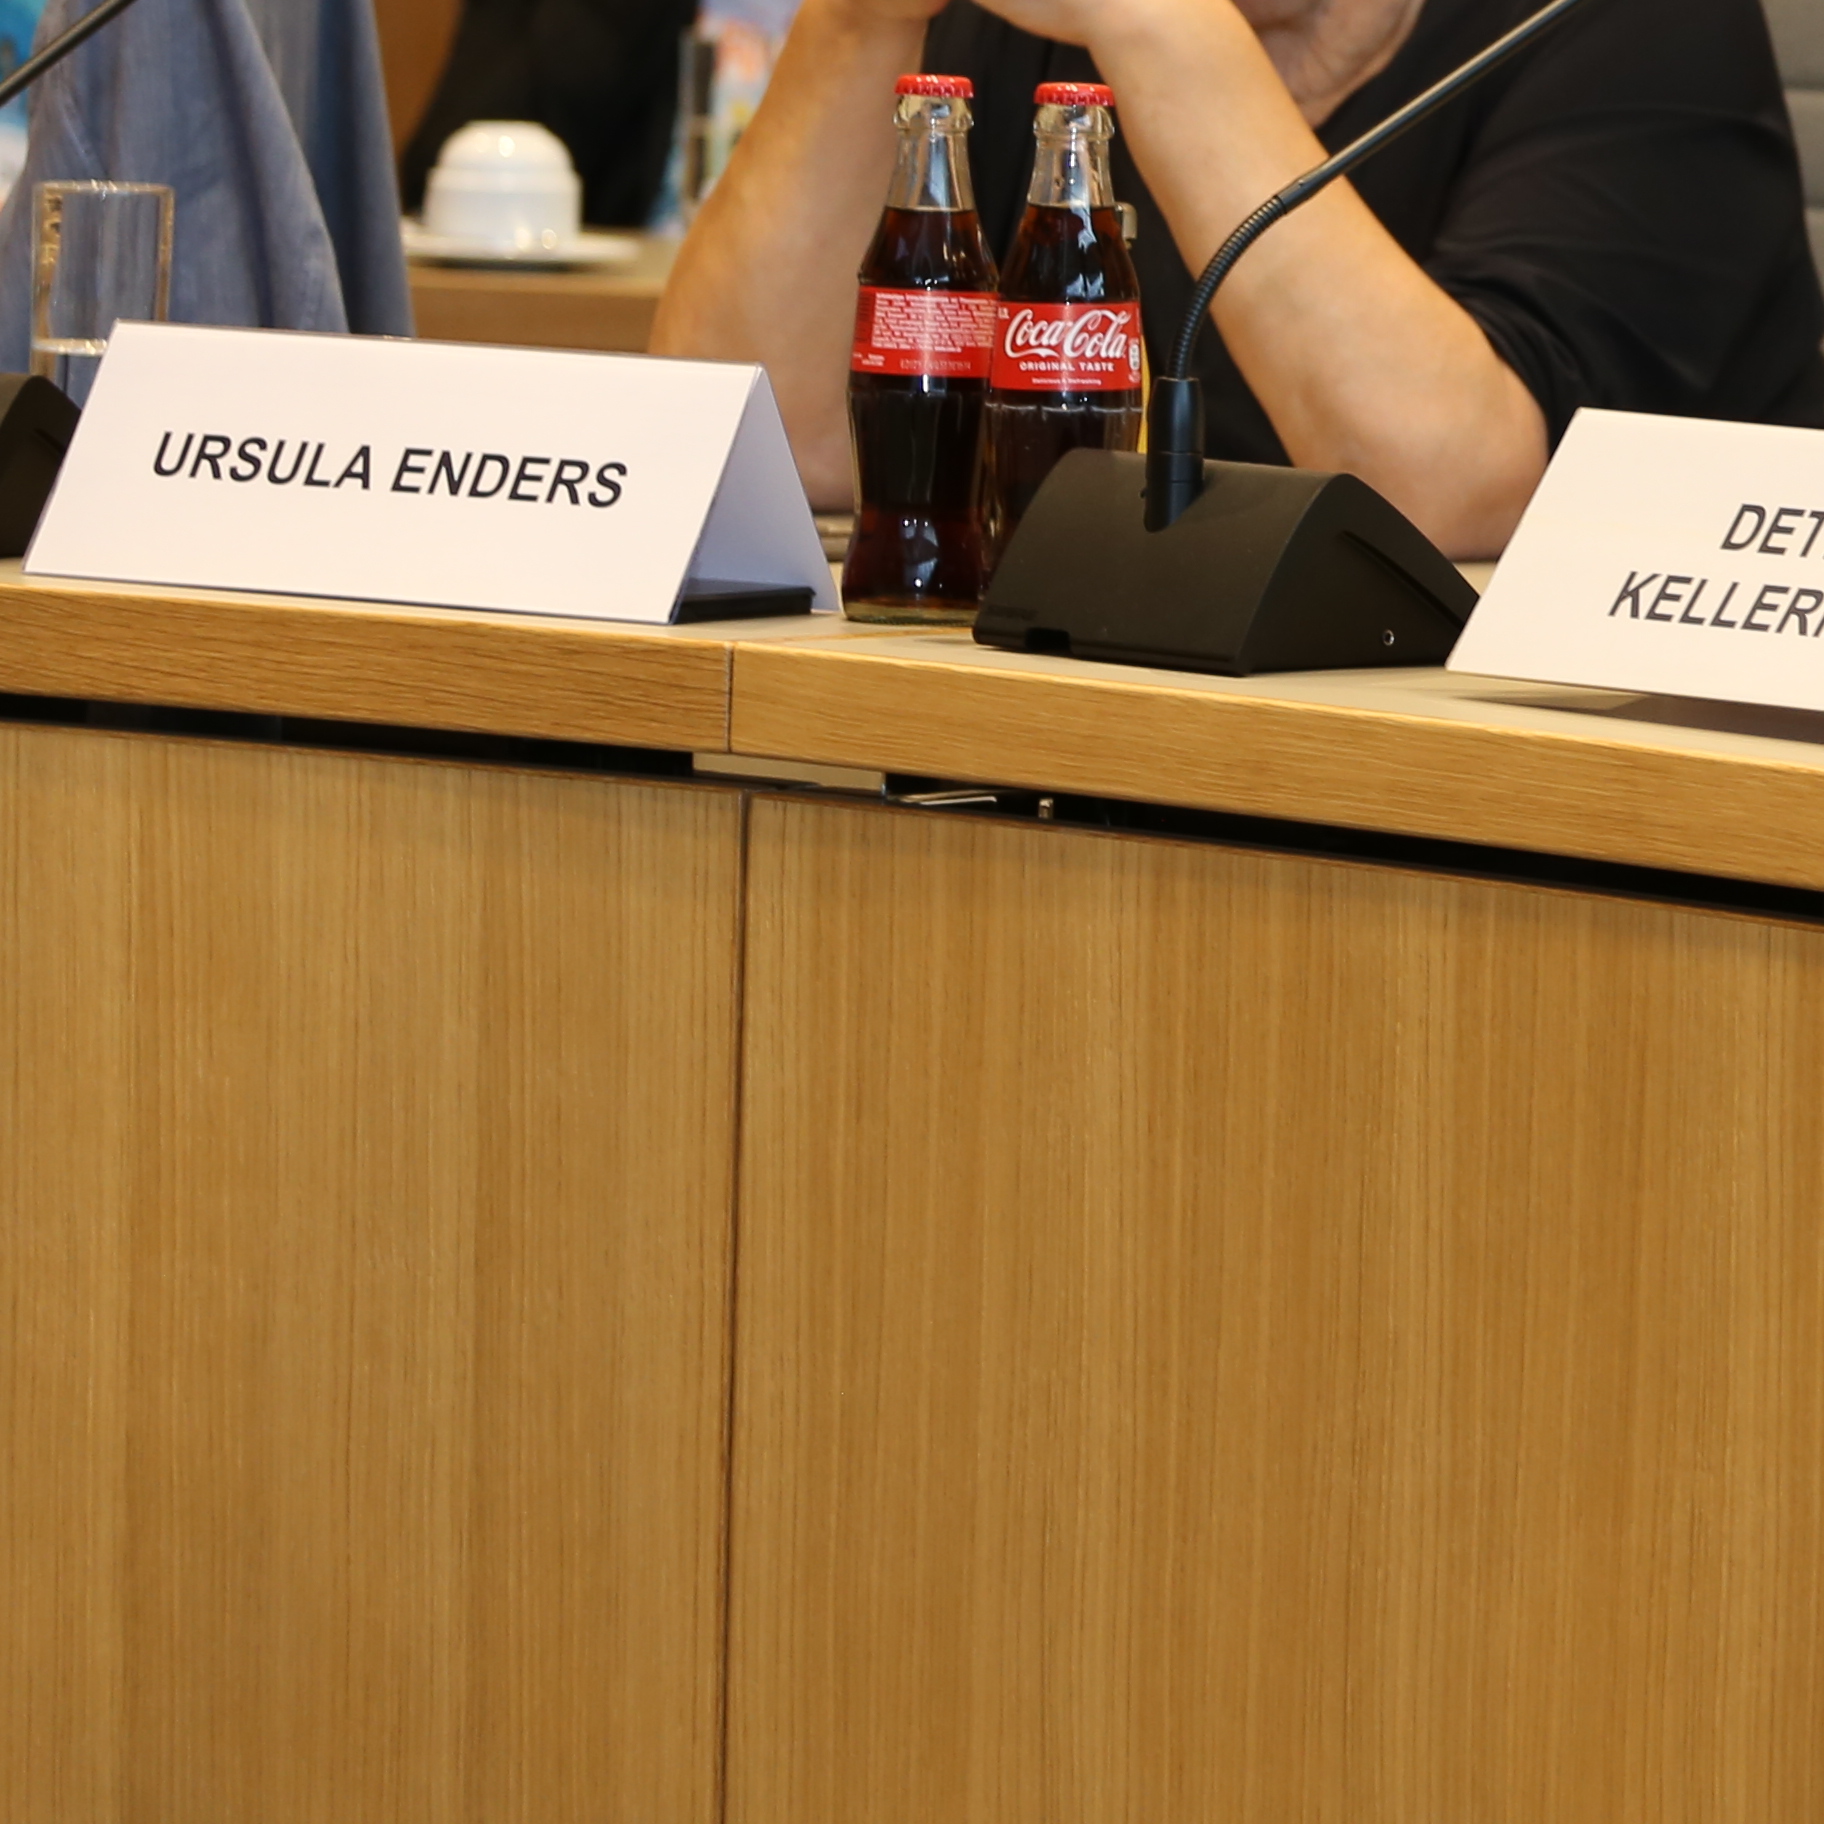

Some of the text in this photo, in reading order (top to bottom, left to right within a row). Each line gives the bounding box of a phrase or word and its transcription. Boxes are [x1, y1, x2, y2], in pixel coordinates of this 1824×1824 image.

[1019, 361, 1115, 373] ORIGINAL TASTE
[153, 431, 628, 509] URSULA ENDERS
